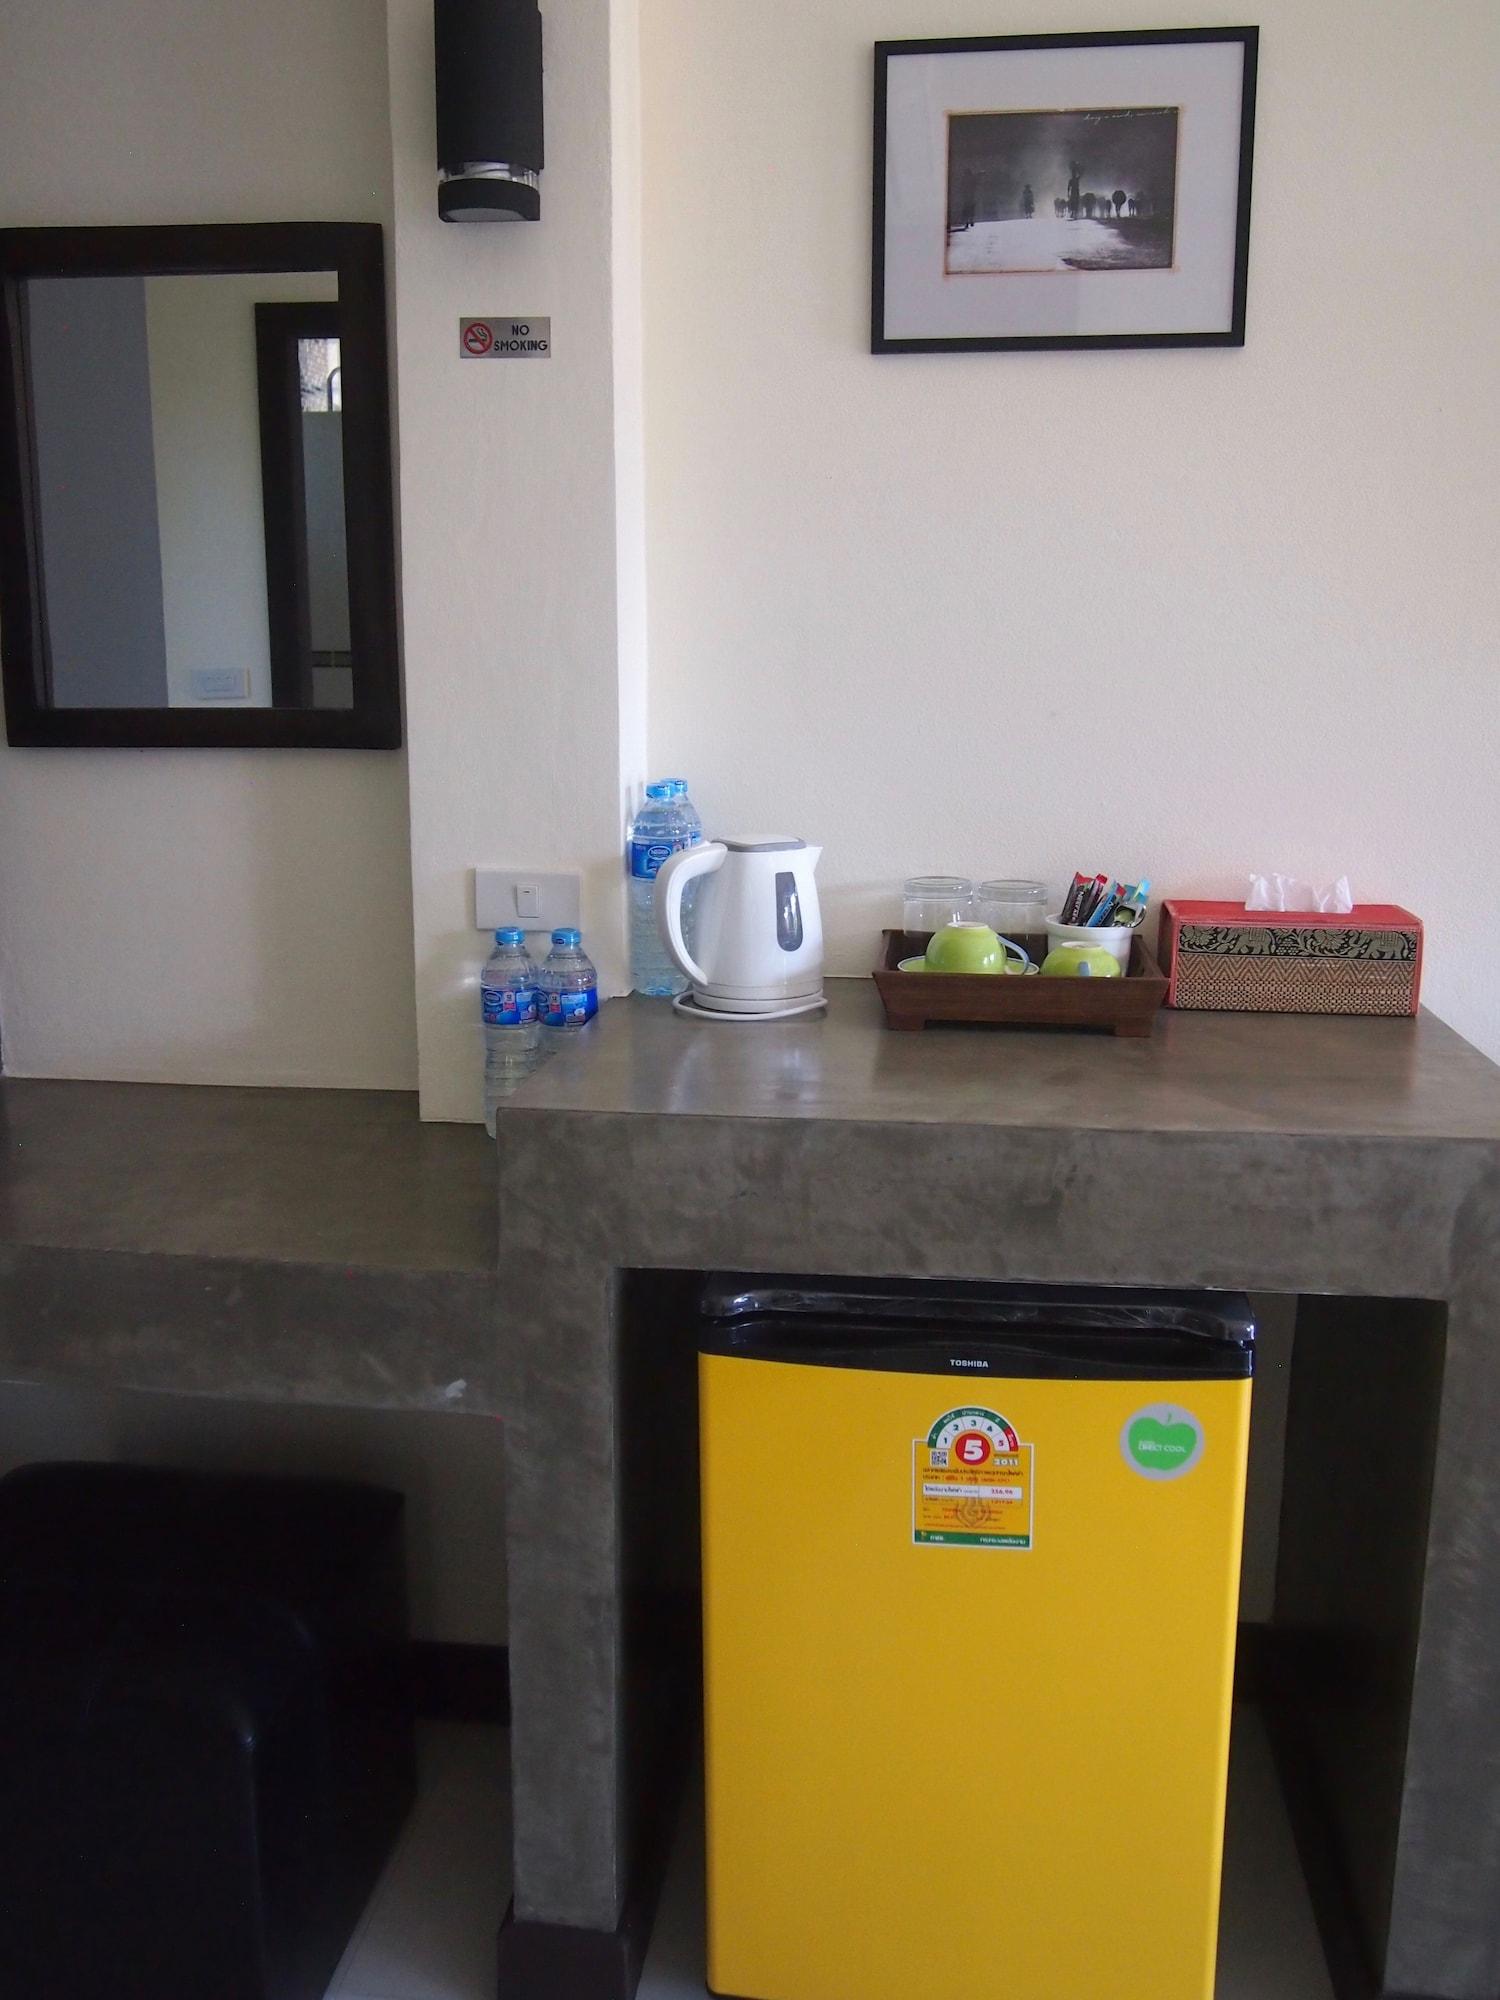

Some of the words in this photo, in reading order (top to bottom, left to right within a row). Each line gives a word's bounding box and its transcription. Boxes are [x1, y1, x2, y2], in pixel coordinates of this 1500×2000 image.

[511, 325, 530, 336] NO
[494, 340, 548, 351] SMOKING
[950, 1359, 989, 1368] TOSHIBA
[970, 1419, 977, 1427] 3
[963, 1439, 984, 1461] 5
